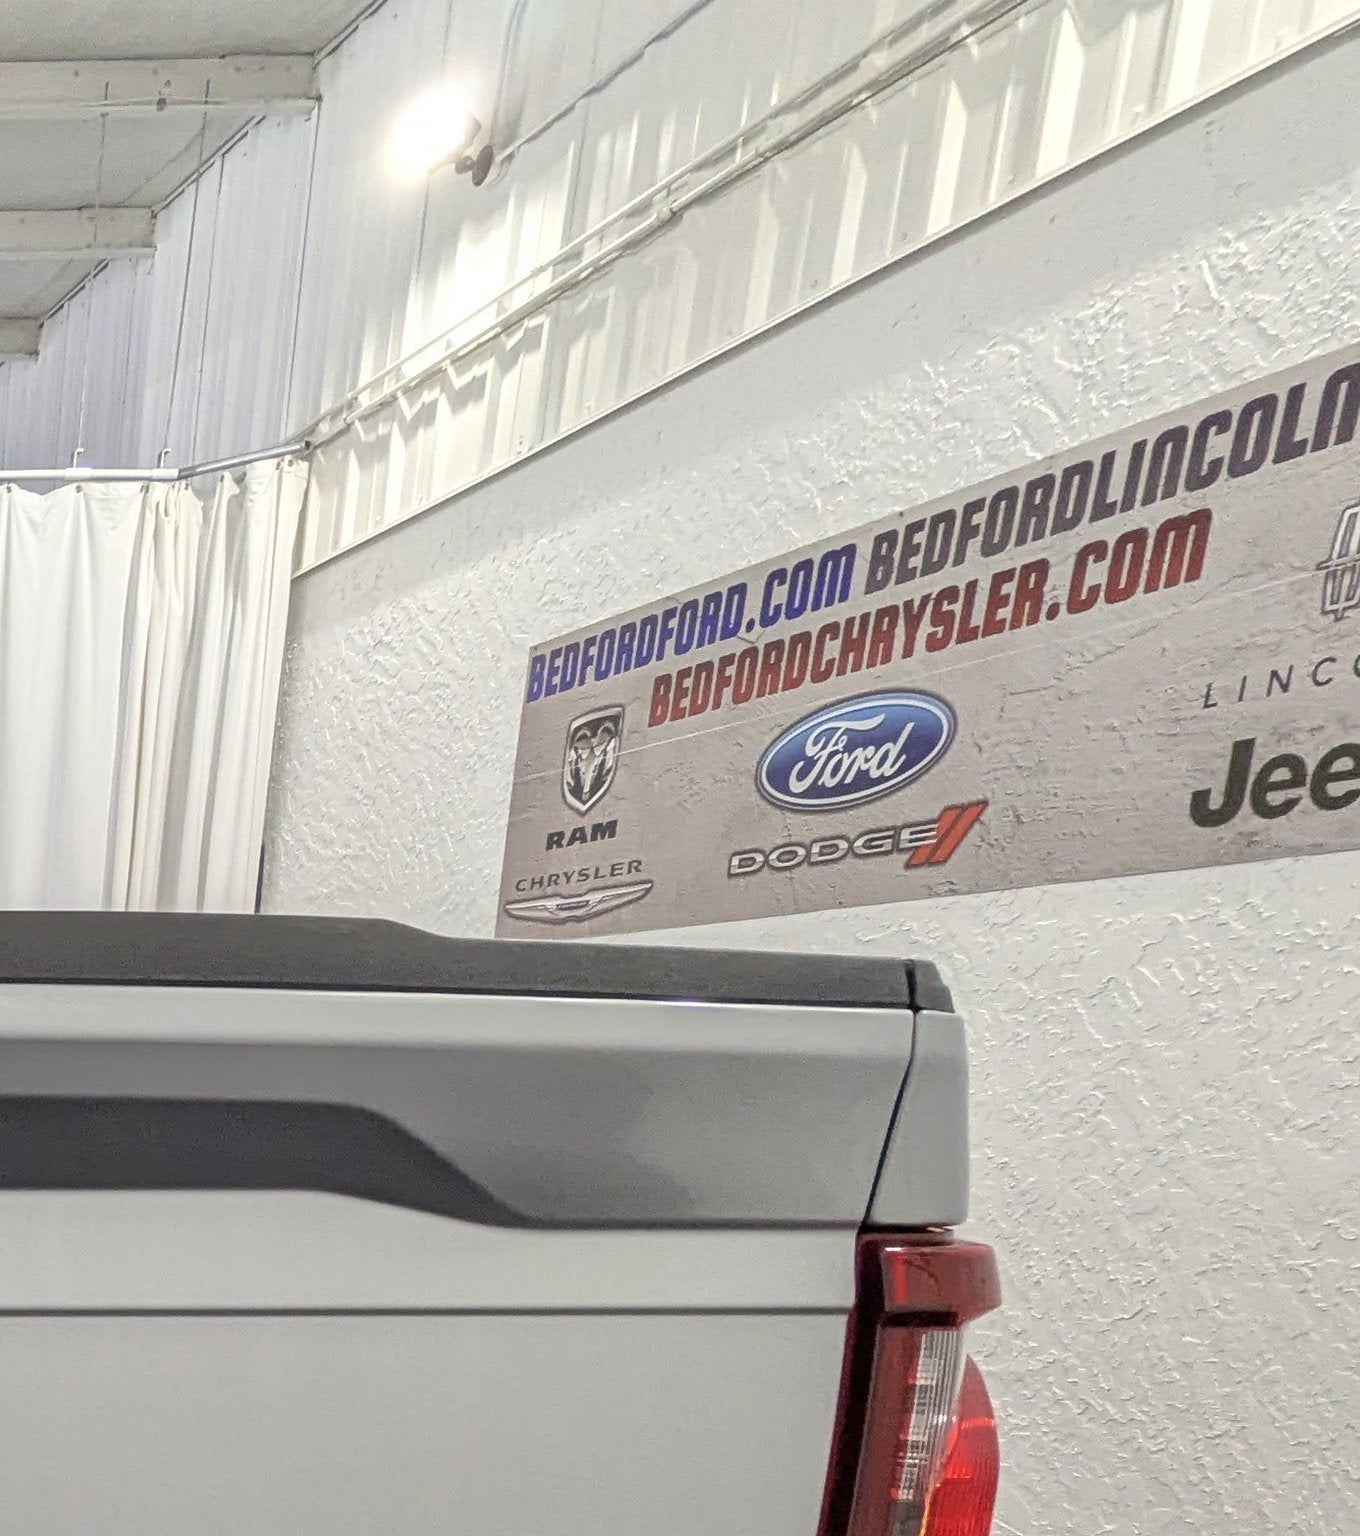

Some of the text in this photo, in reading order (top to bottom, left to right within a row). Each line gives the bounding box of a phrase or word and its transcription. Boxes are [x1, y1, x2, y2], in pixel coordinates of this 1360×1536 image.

[527, 543, 857, 702] BEDFORDFORD.COM
[647, 508, 1213, 728] BEDFORDCHRYSLER.COM
[789, 713, 915, 793] Ford
[545, 819, 619, 851] RAM
[728, 821, 939, 878] DODGE
[515, 859, 643, 893] CHRYSLER
